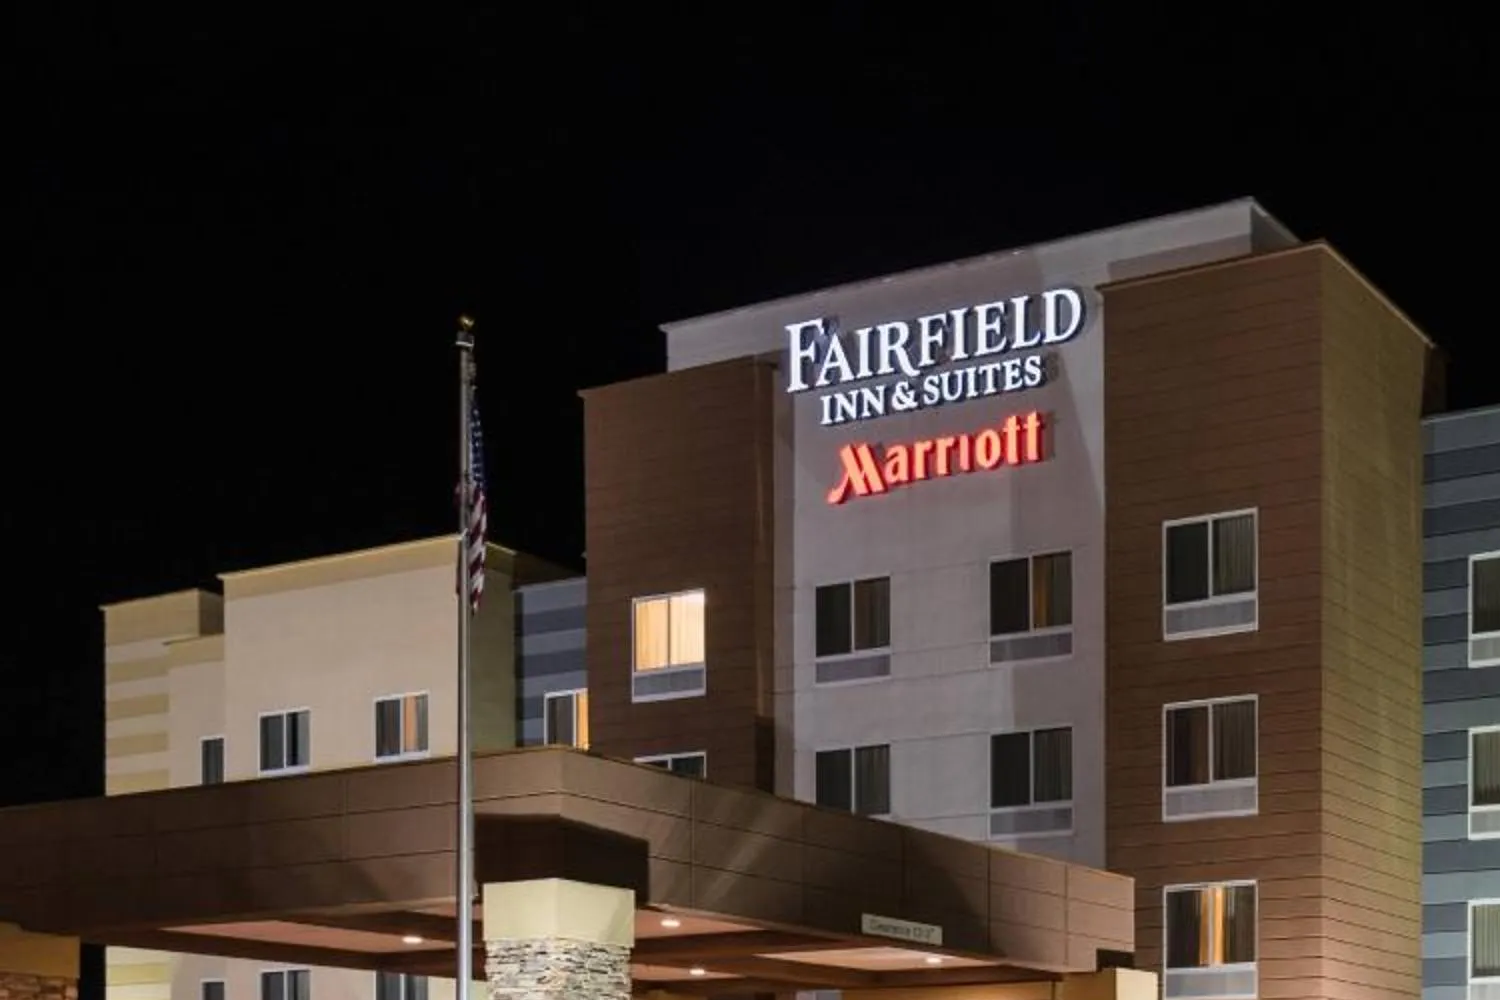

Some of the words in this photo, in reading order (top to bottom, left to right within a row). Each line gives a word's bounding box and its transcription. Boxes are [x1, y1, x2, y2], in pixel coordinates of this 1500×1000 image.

[785, 288, 1082, 393] FAIRFIELD
[820, 391, 885, 425] INN
[890, 381, 918, 411] &
[922, 355, 1043, 406] SUITES
[826, 411, 1044, 505] Marriott
